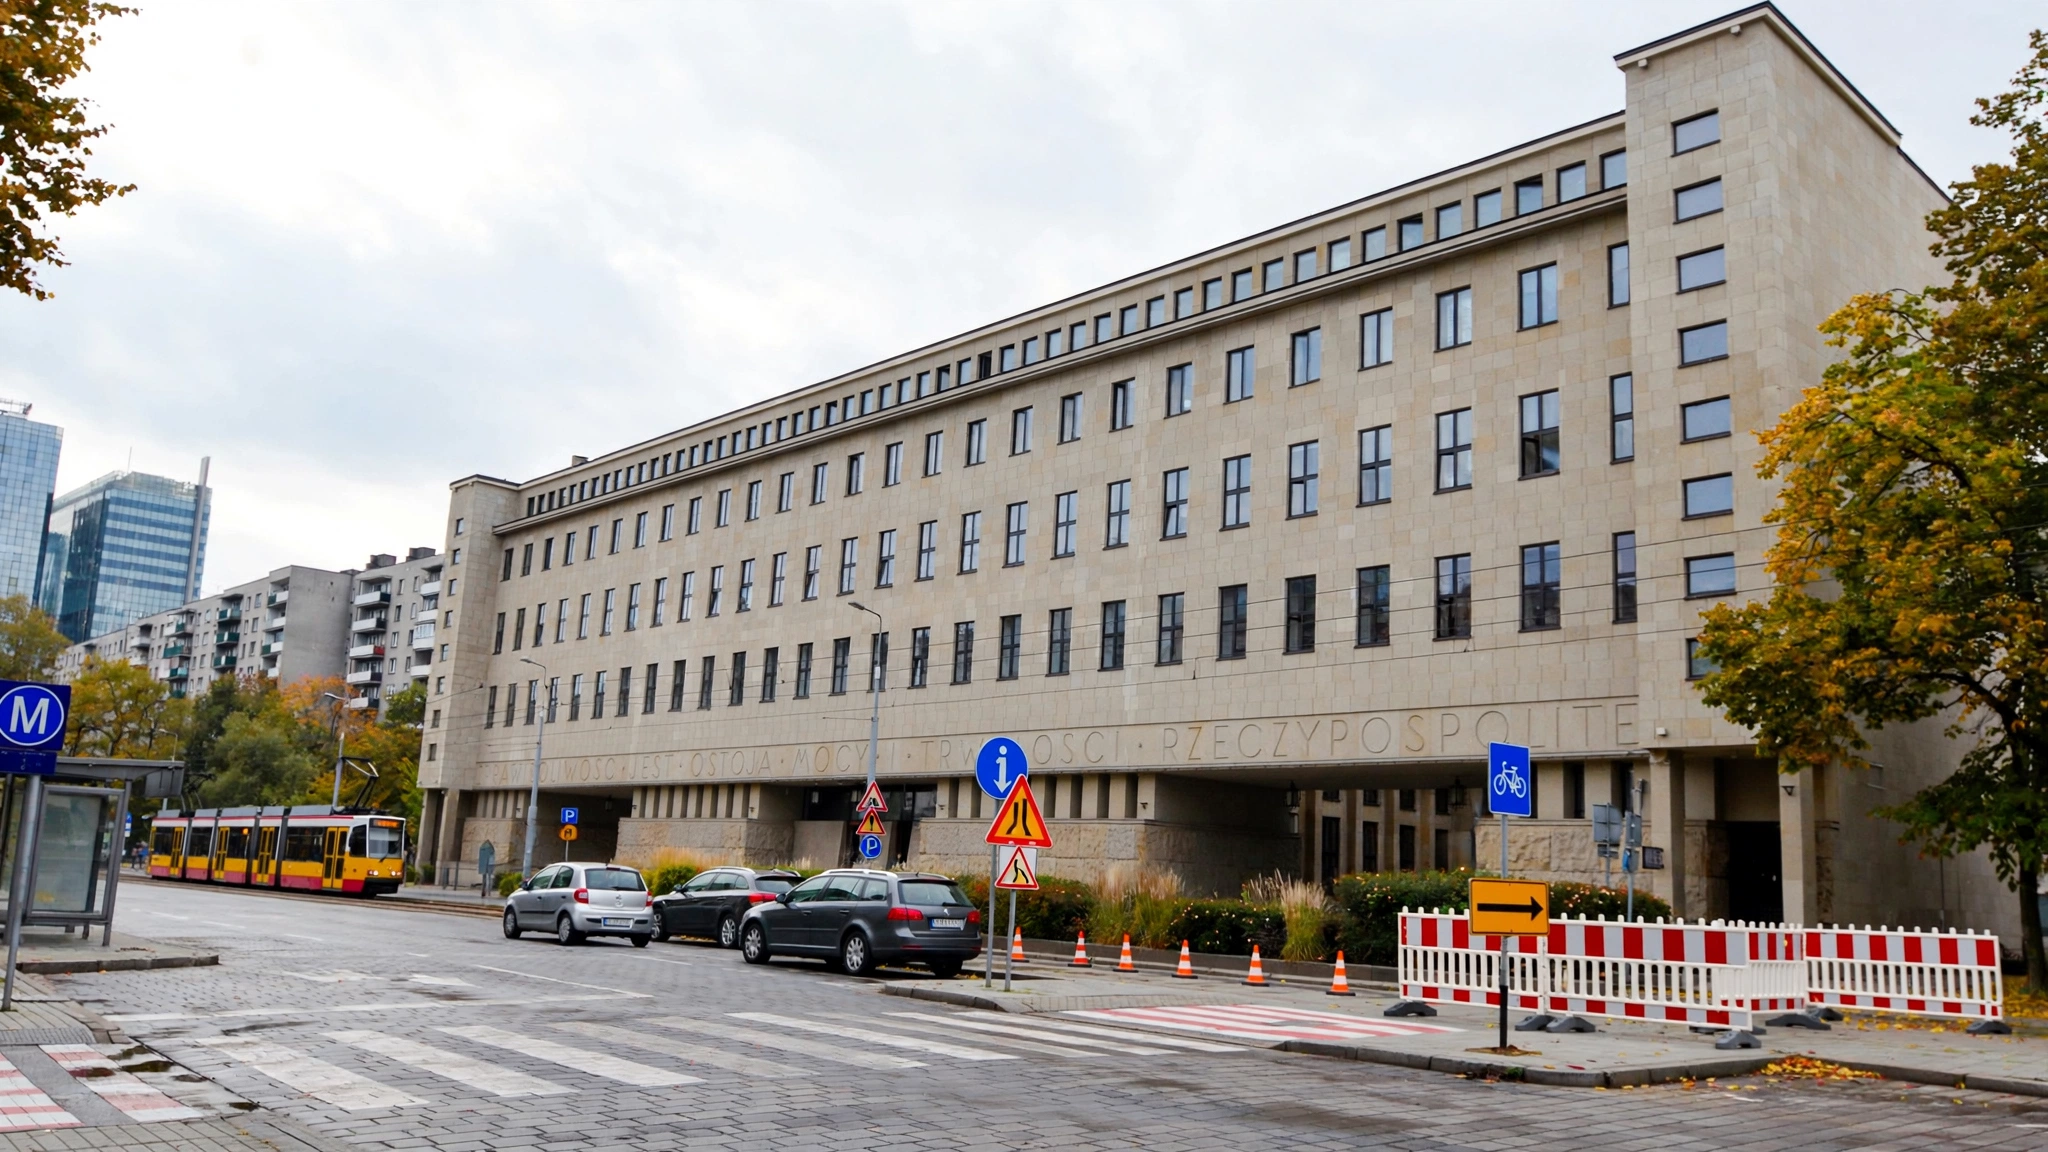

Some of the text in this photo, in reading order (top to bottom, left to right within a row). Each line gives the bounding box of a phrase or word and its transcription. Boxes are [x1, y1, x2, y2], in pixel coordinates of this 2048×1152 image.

[9, 695, 50, 735] M
[630, 754, 674, 780] JEST
[691, 749, 774, 777] OSTOJA
[792, 743, 869, 774] MOCY
[921, 731, 1120, 769] TRWOSCI
[565, 809, 575, 823] P
[866, 837, 878, 857] P
